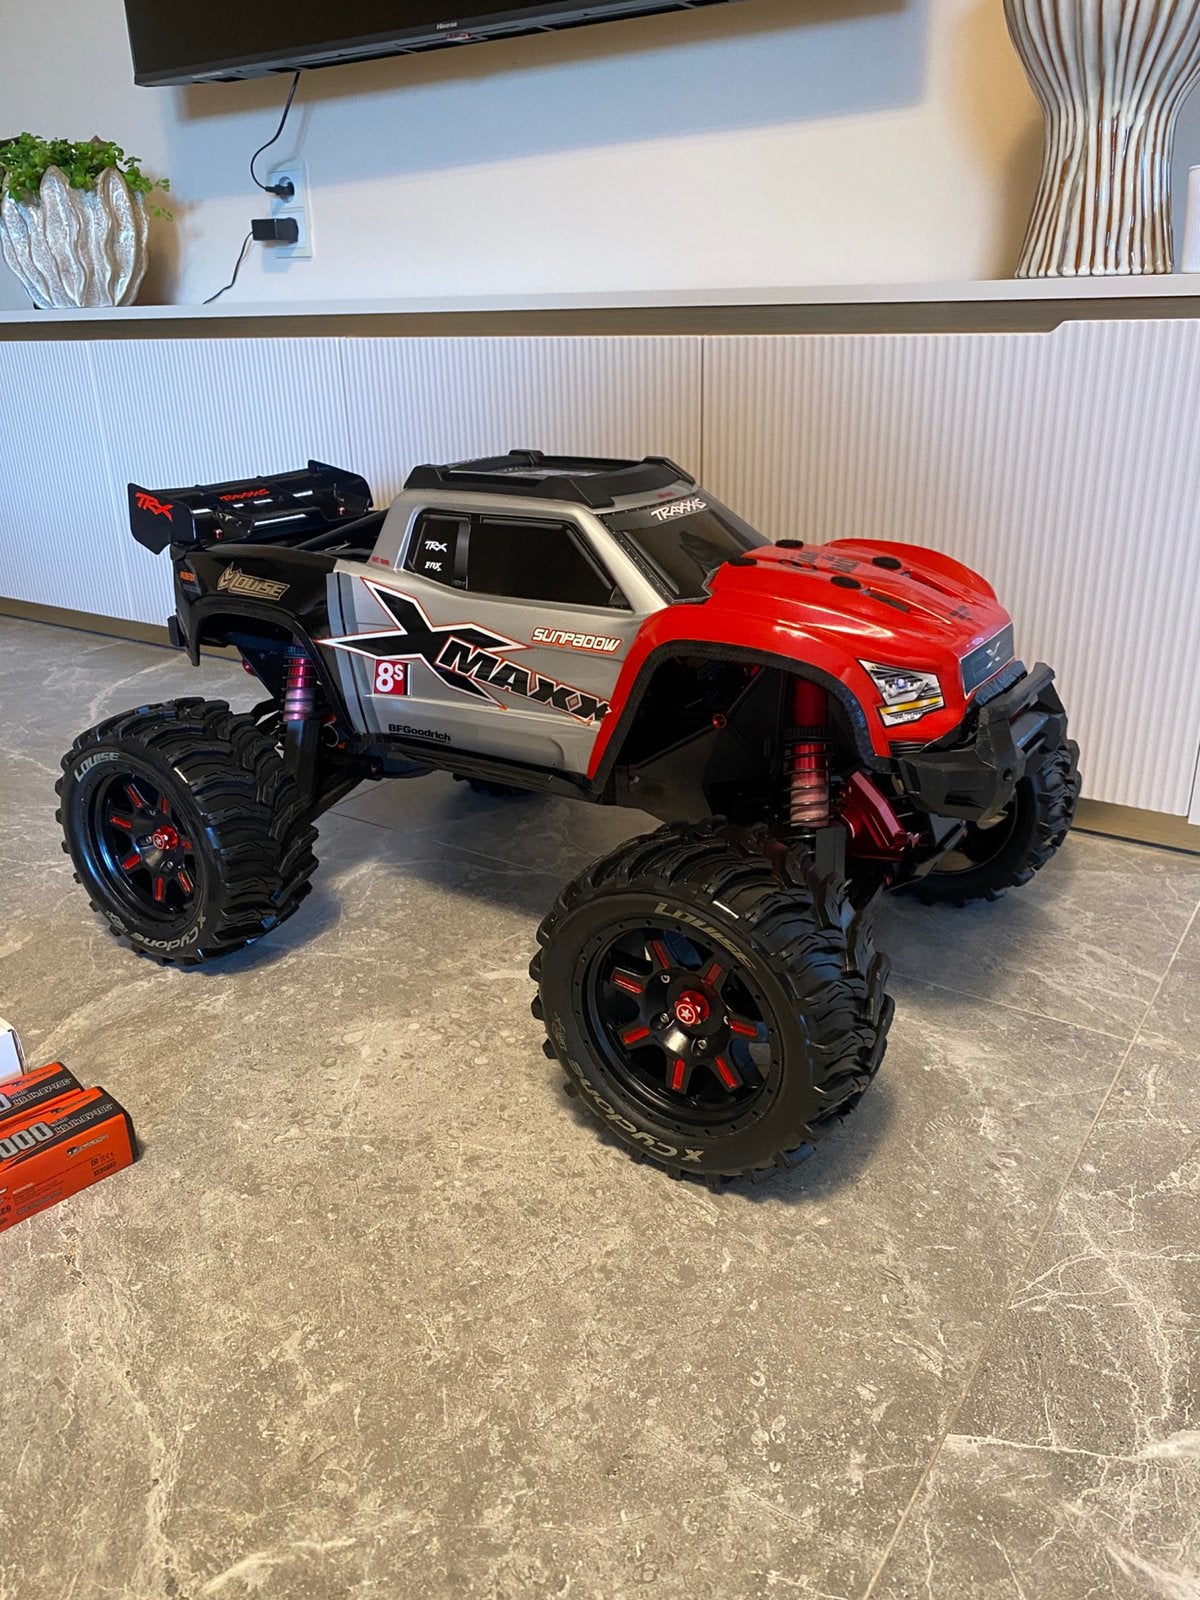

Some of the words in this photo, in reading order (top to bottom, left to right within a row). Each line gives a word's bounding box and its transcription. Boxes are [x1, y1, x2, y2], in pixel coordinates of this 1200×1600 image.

[135, 492, 174, 521] TRX
[650, 498, 707, 521] TRAXXAS
[424, 540, 448, 553] TRX
[388, 723, 452, 743] BFGoodrich
[74, 751, 120, 782] LOUISE
[655, 902, 757, 970] LOUISE
